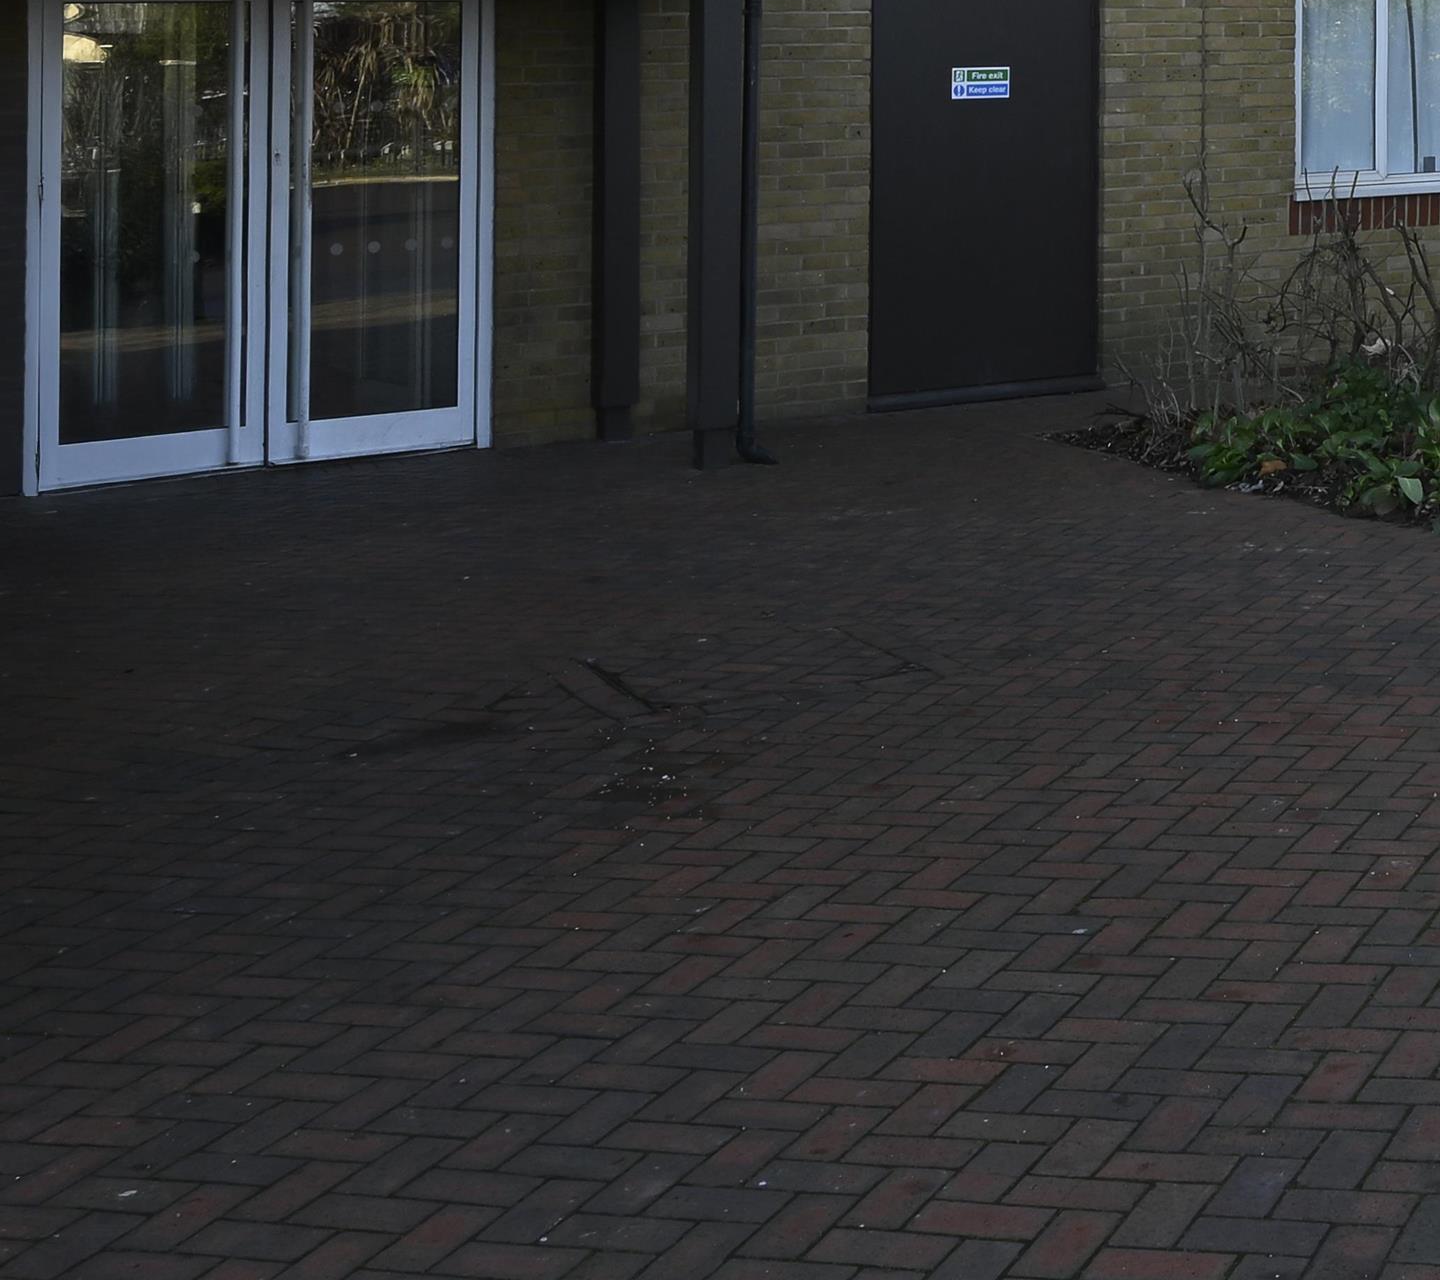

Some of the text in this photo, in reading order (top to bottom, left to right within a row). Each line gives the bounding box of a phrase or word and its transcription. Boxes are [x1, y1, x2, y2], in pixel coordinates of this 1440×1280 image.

[971, 71, 1003, 80] Fire exit
[968, 86, 987, 94] Keep
